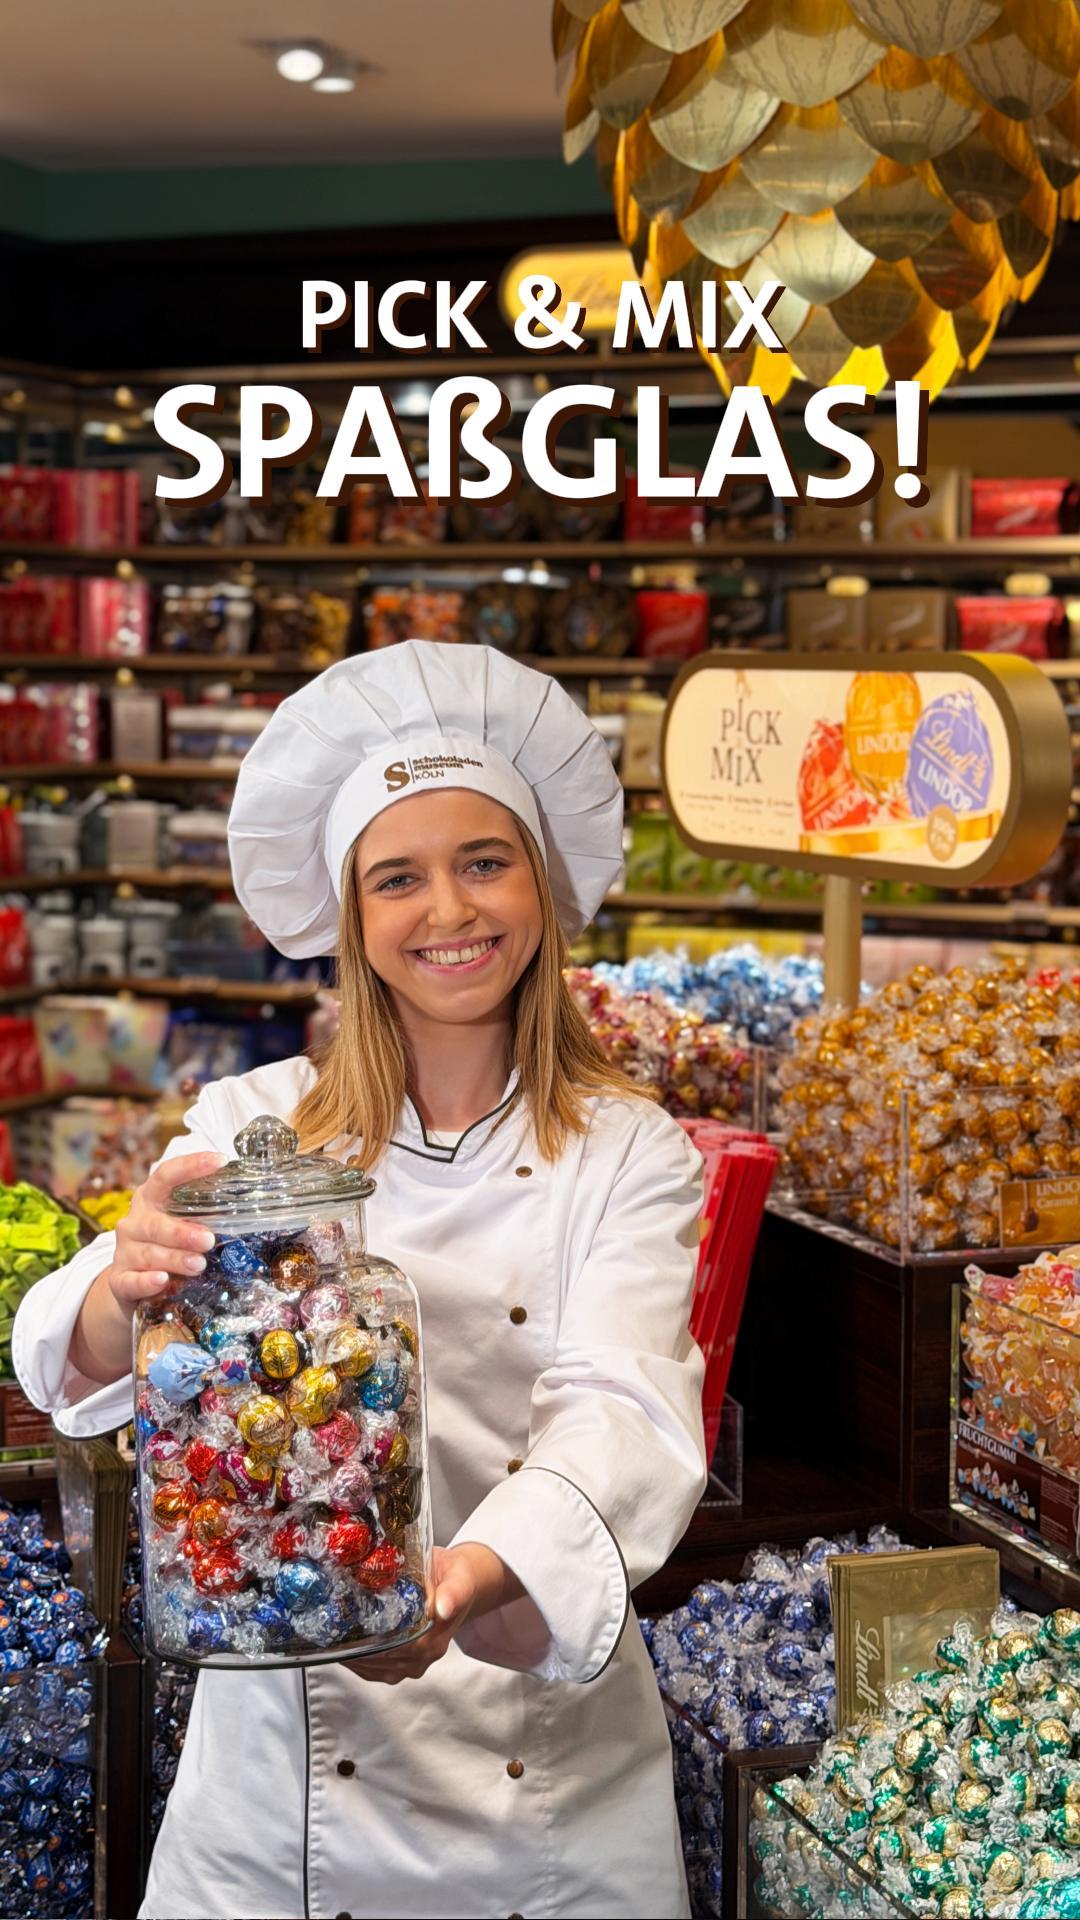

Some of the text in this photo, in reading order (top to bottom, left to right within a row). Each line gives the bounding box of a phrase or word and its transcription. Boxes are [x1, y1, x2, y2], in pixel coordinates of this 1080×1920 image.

[720, 698, 782, 746] PICK
[383, 761, 411, 793] S
[412, 754, 484, 768] schokoladen
[413, 762, 465, 772] museum
[414, 770, 445, 781] KÖLN
[710, 746, 763, 787] MIX
[958, 1423, 1017, 1465] FRUCHTGUMMI
